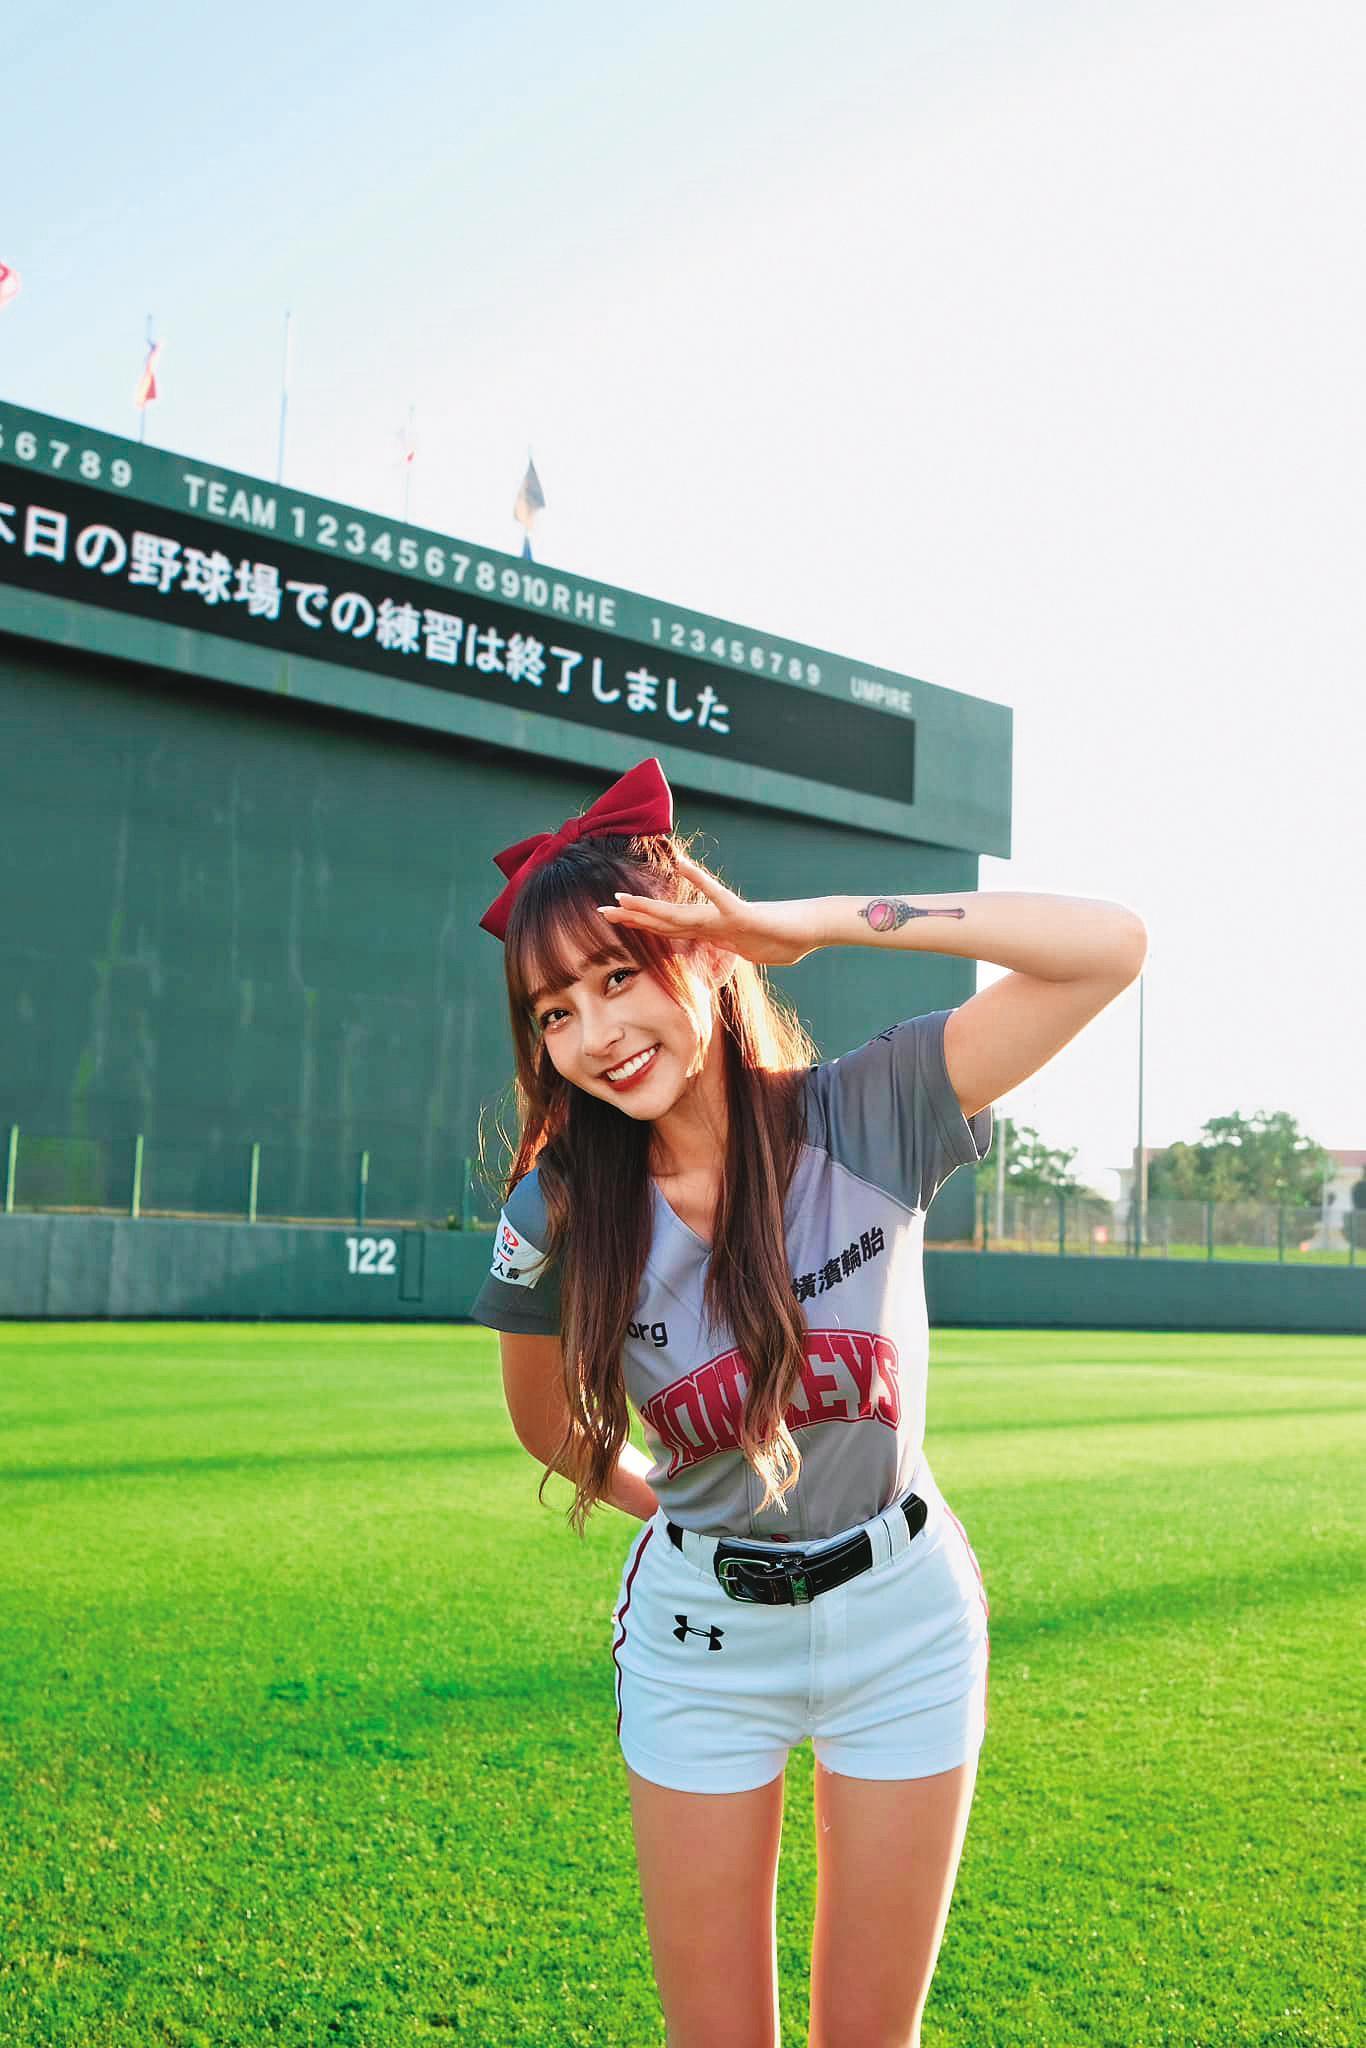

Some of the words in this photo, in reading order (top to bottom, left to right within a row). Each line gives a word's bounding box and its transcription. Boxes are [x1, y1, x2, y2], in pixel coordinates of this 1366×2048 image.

[183, 474, 277, 531] TEAM
[849, 675, 913, 714] UMPIRE
[345, 1237, 397, 1275] 122
